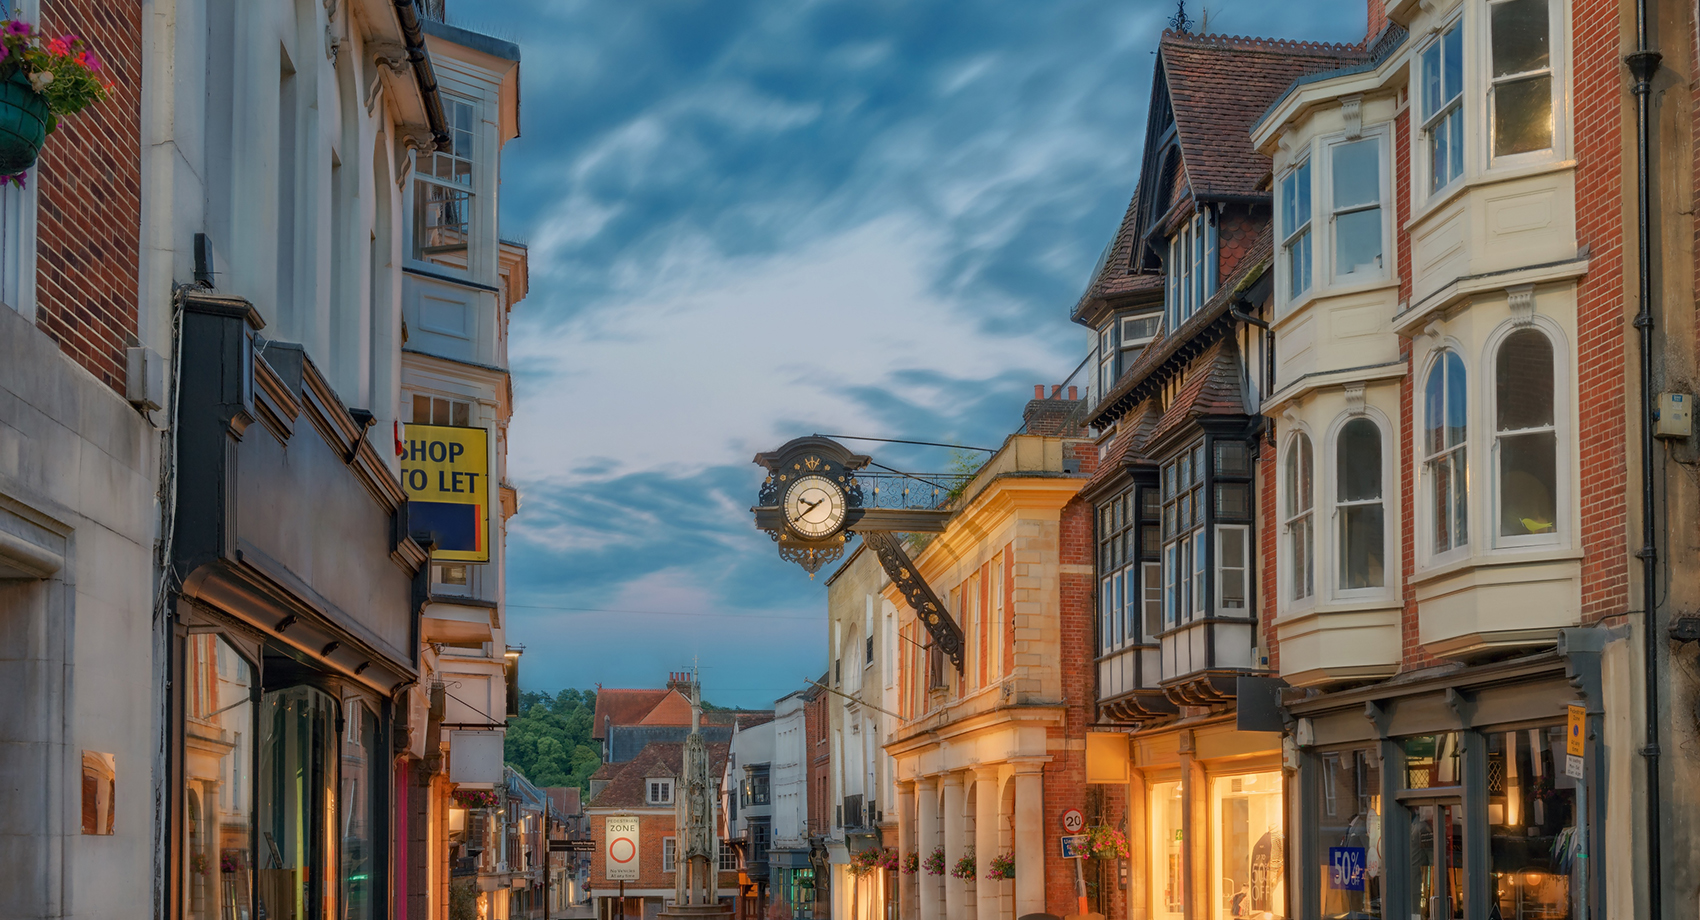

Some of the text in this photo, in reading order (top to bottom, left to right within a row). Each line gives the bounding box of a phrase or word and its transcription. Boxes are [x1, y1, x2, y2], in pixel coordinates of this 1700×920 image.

[439, 471, 479, 493] LET
[1066, 815, 1081, 827] 20
[1334, 851, 1360, 885] 50%
[1252, 886, 1270, 901] OFF
